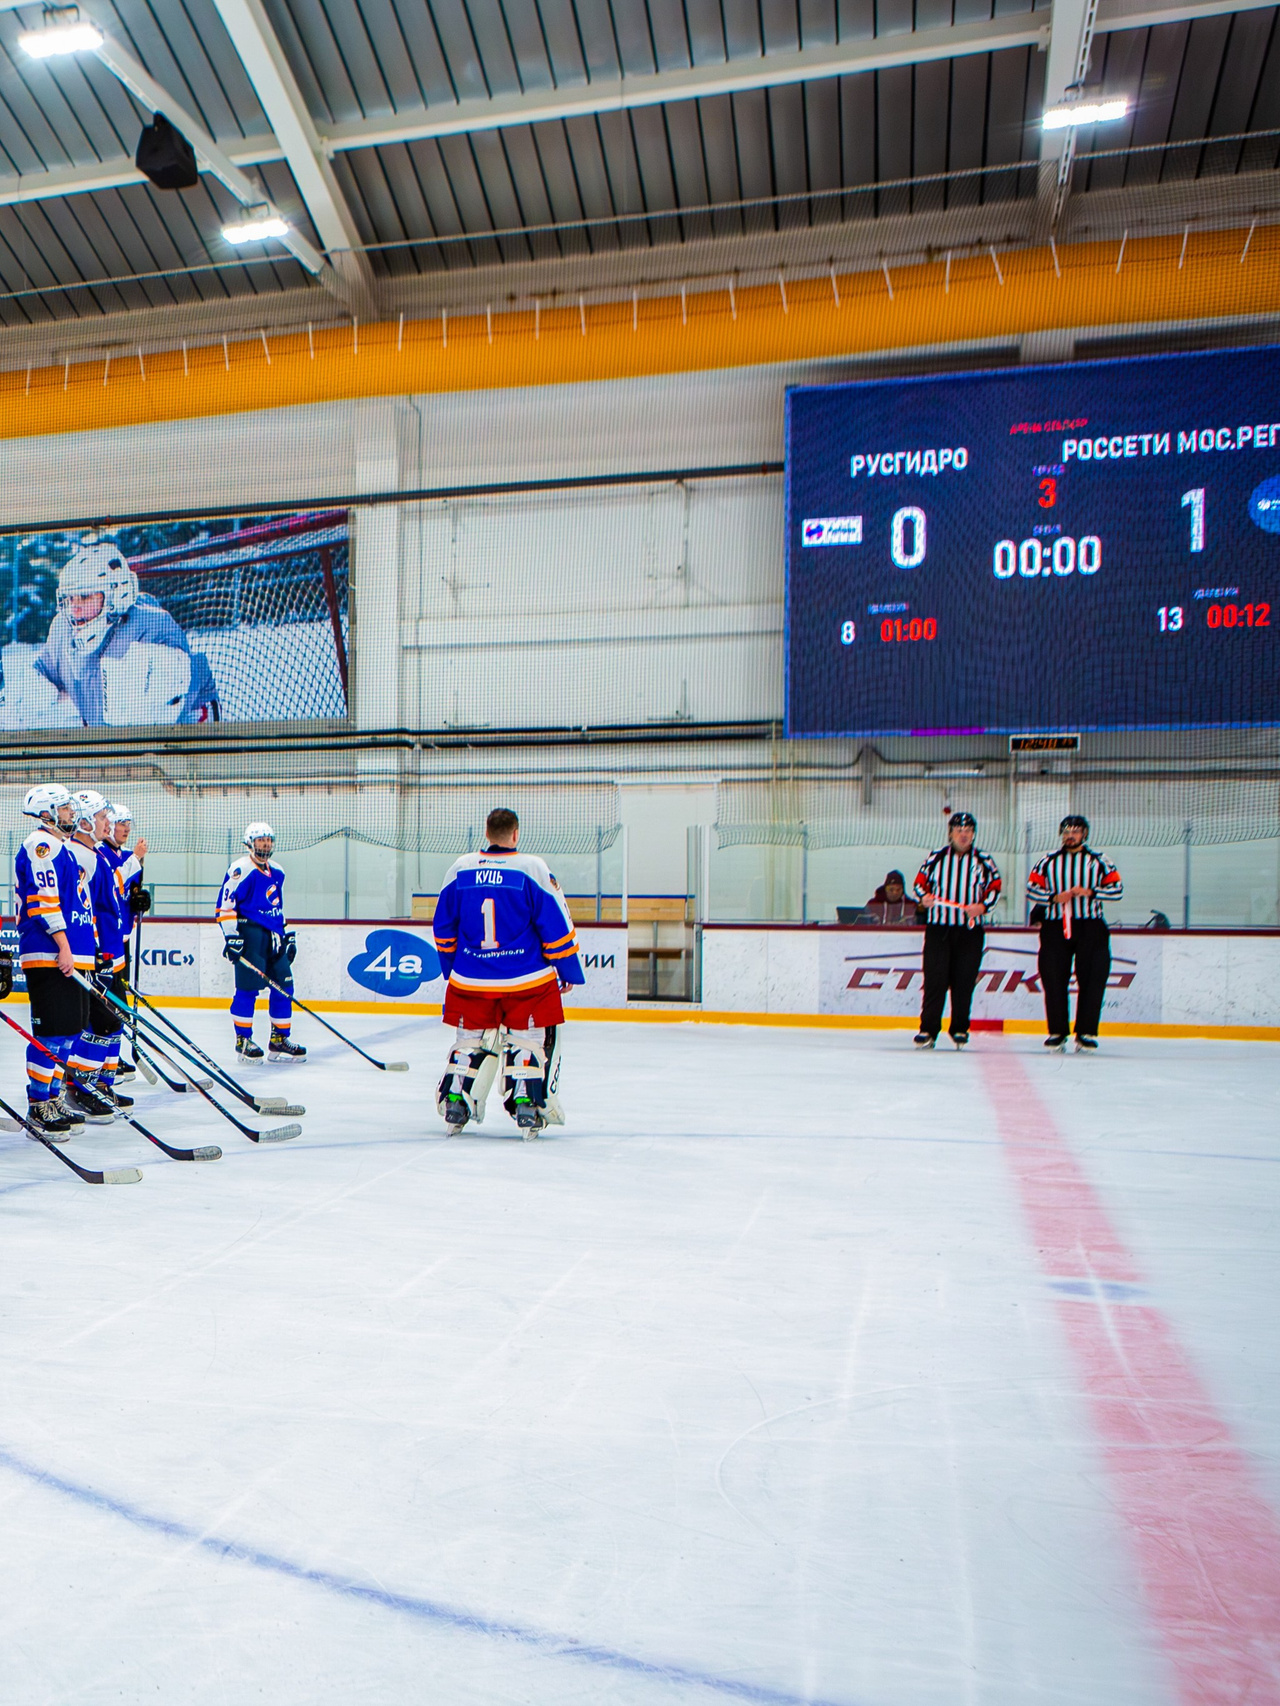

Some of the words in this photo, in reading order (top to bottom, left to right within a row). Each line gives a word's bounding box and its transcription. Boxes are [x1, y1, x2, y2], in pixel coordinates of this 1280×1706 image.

[850, 447, 969, 479] РУСГИДРО
[1062, 432, 1171, 463] РОССЕТИ
[1037, 477, 1057, 509] 3
[1180, 487, 1206, 553] 1
[891, 505, 927, 570] 0
[992, 535, 1102, 580] 00:00
[840, 620, 856, 645] 8
[880, 617, 937, 642] 01:00
[1157, 606, 1183, 632] 13
[1207, 603, 1271, 629] 00:12
[36, 869, 56, 888] 96
[475, 869, 504, 885] КУЦЬ
[480, 897, 500, 950] 1
[129, 948, 195, 967] КПС»
[846, 967, 1138, 994] СТЛКР
